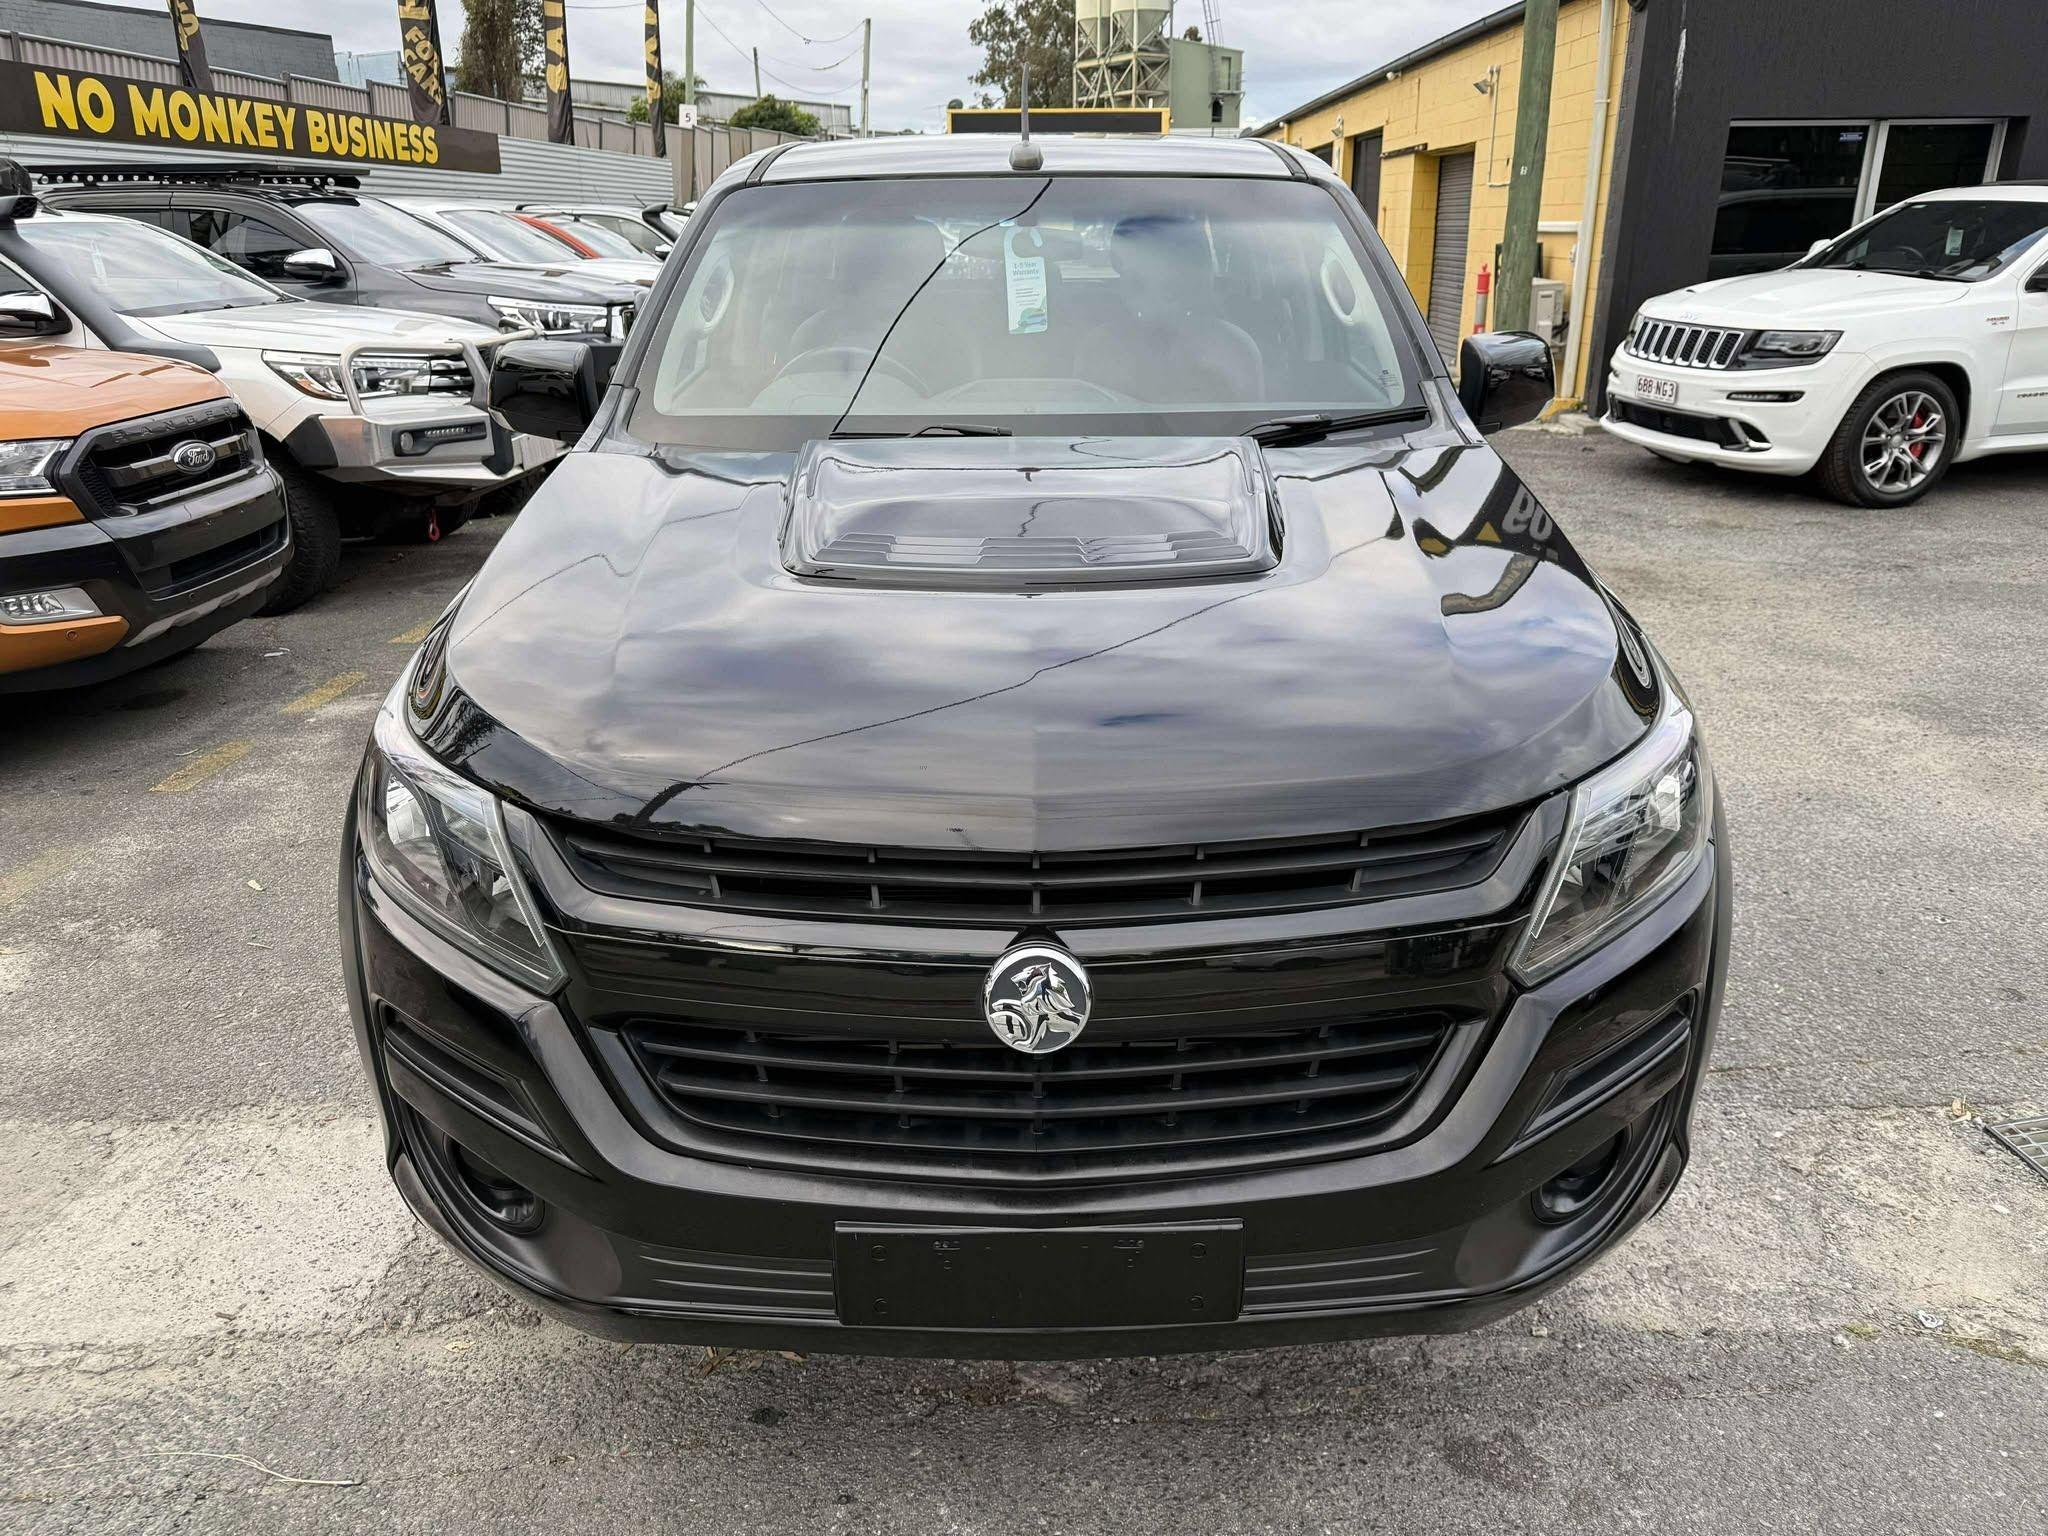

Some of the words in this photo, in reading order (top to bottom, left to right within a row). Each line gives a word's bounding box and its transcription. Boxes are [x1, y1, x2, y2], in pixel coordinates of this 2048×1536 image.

[34, 71, 115, 134] NO
[127, 84, 296, 150] MONKEY
[305, 109, 439, 165] BUSINESS
[685, 112, 691, 123] 5
[187, 447, 209, 466] Ford
